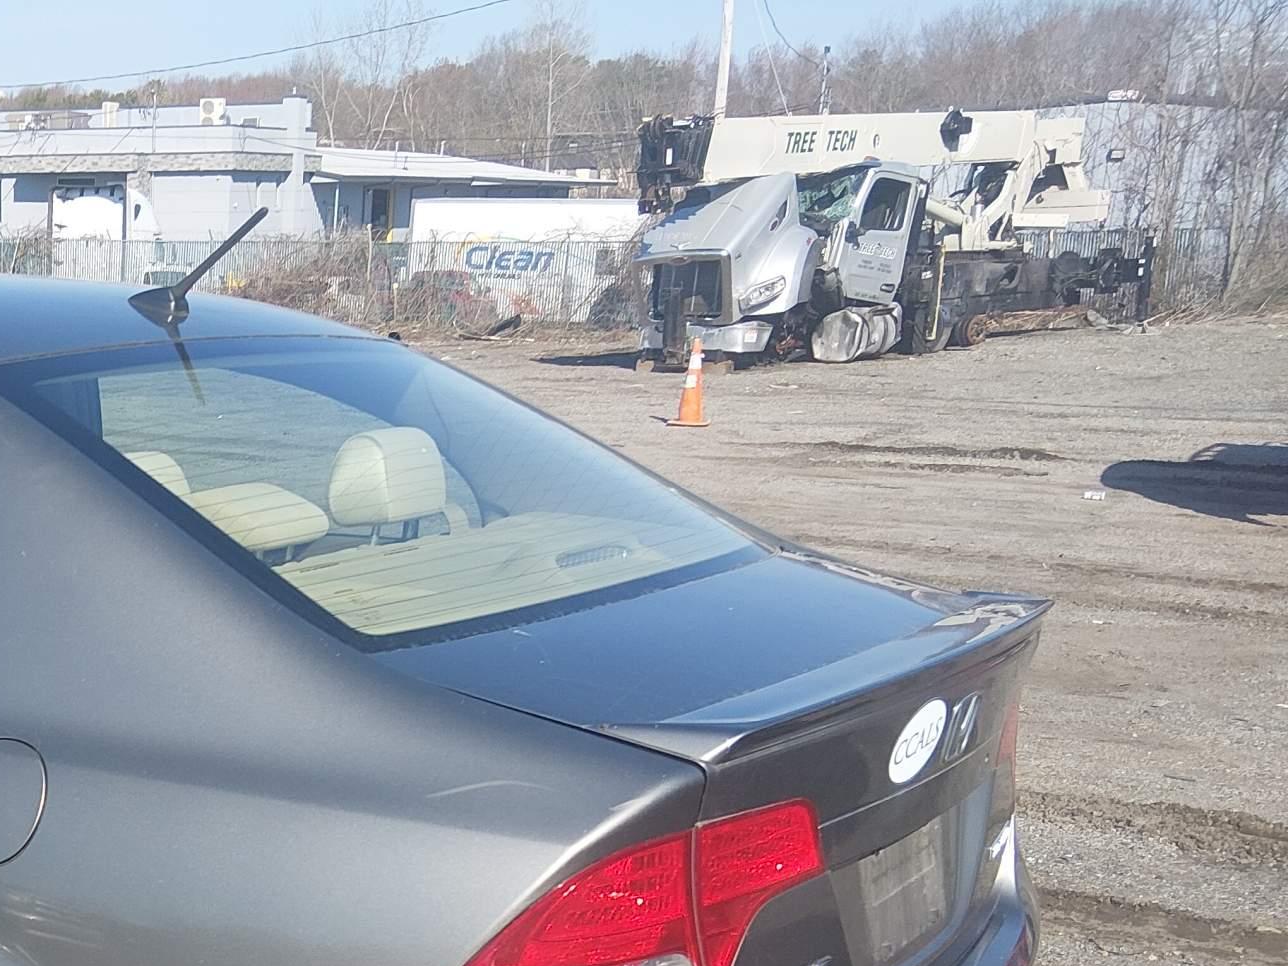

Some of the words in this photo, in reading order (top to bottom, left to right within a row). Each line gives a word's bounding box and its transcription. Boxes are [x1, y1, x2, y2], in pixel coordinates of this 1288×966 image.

[785, 131, 817, 154] TREE
[826, 129, 858, 153] TECH
[465, 246, 555, 271] Clean
